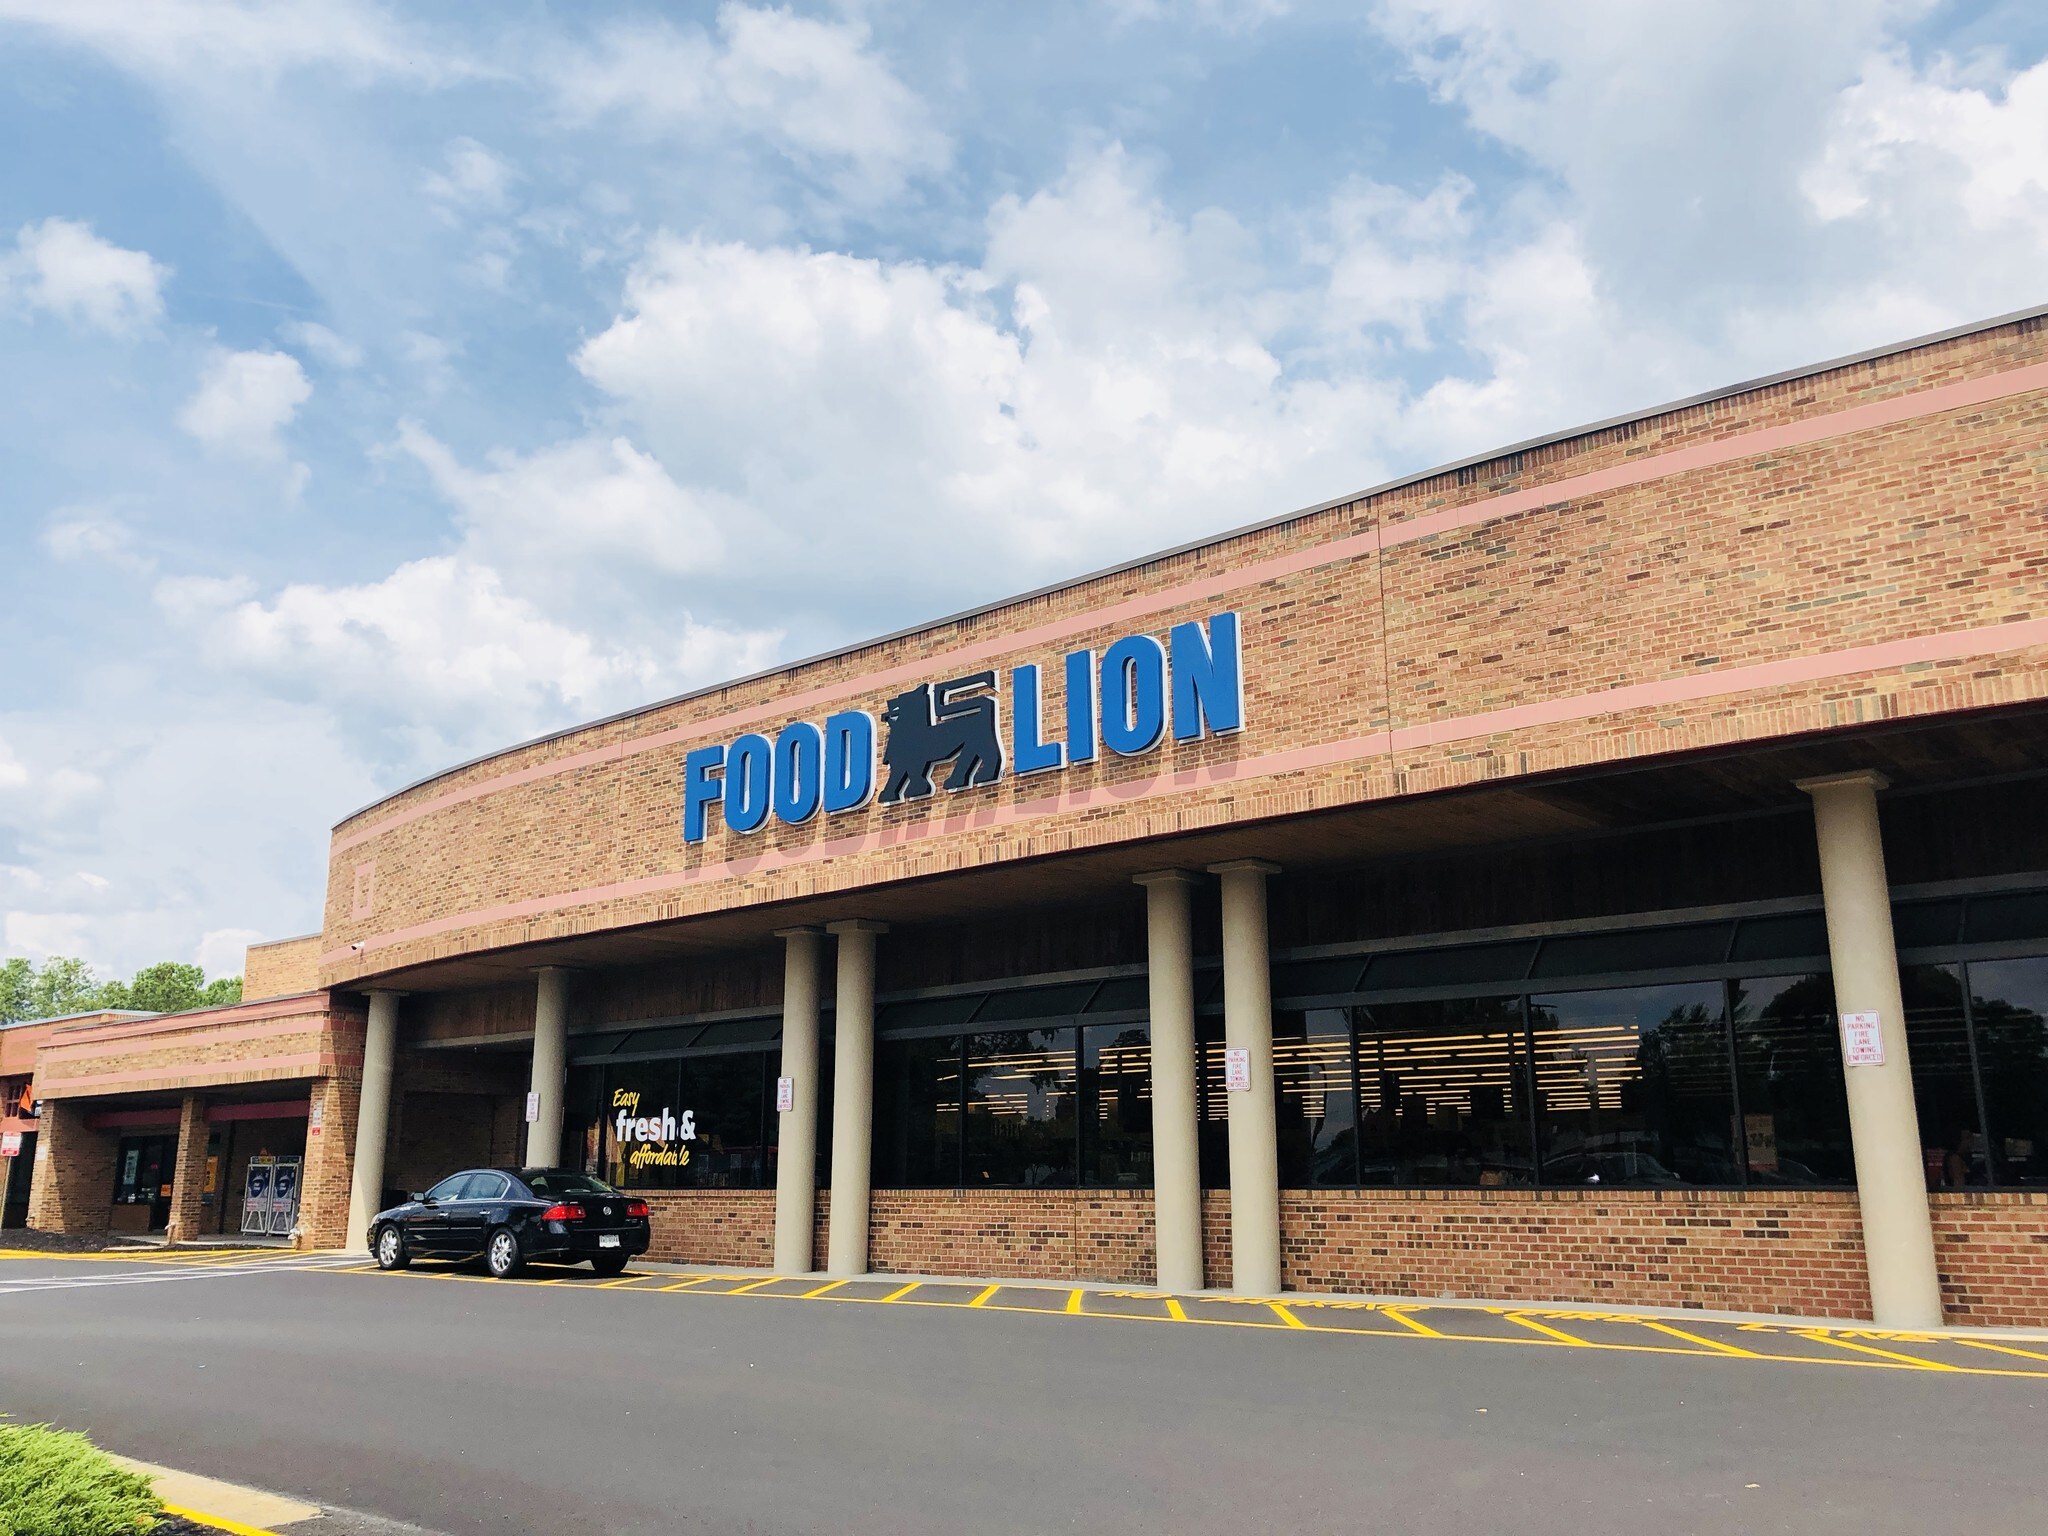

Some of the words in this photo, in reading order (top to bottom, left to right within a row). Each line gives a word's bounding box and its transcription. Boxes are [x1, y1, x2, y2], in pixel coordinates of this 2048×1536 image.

[684, 710, 878, 845] FOOD
[1012, 611, 1245, 776] LION
[1847, 1022, 1875, 1030] PARKING
[612, 1088, 641, 1117] Easy
[616, 1107, 677, 1142] fresh
[680, 1109, 697, 1141] &
[1198, 1297, 1430, 1311] PARKING
[1503, 1309, 1659, 1323] FIRE
[1735, 1323, 1951, 1343] LANE
